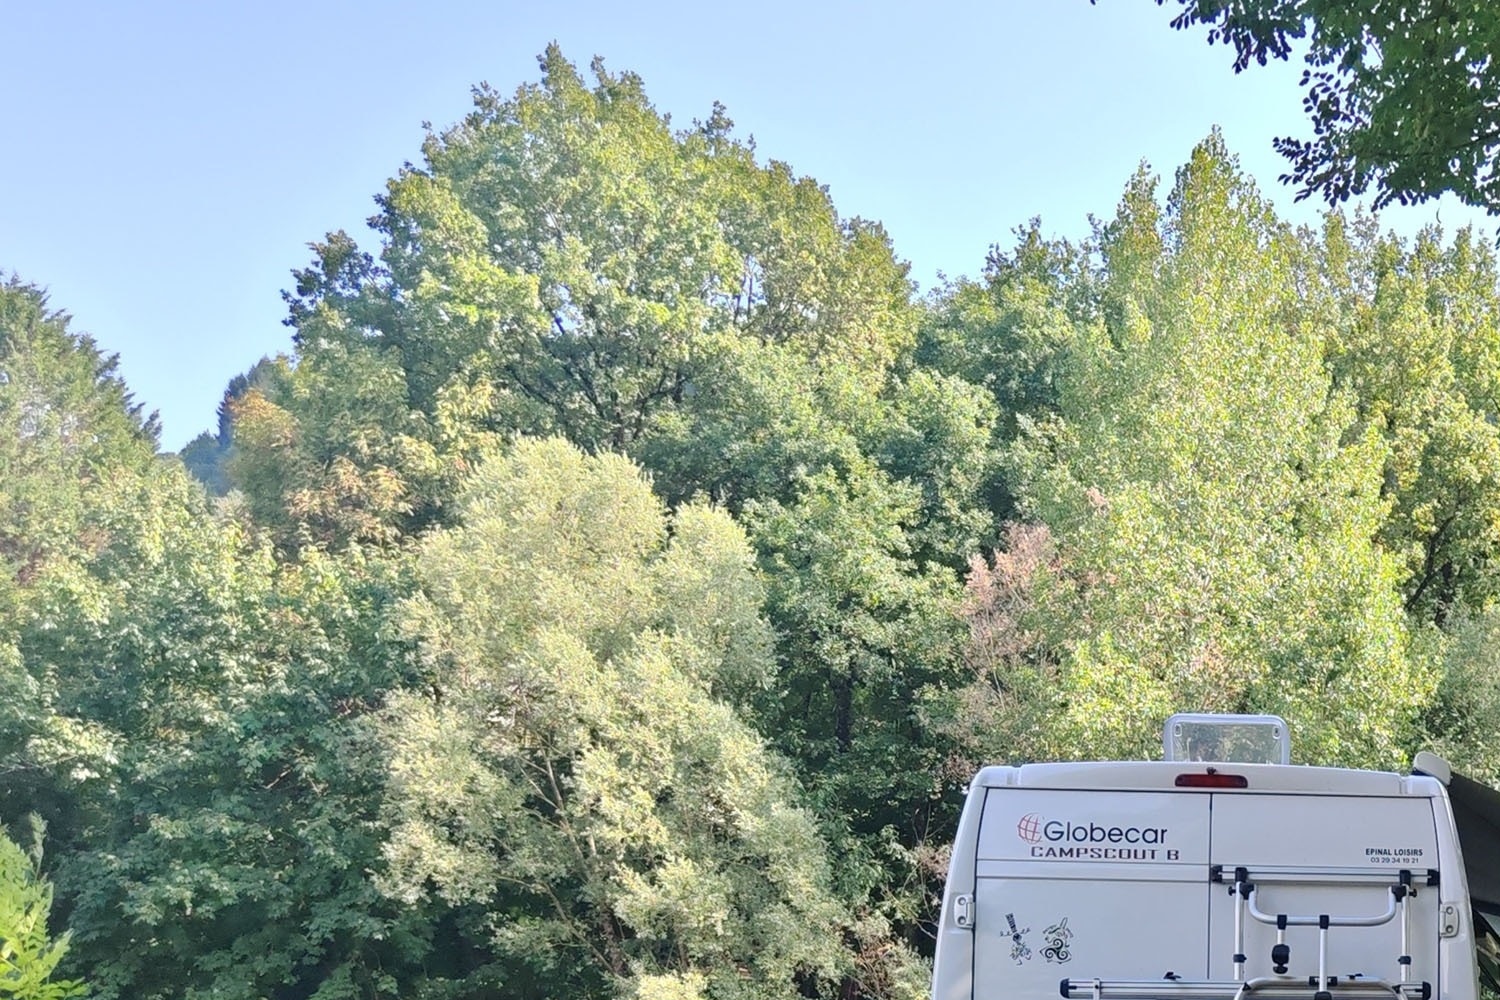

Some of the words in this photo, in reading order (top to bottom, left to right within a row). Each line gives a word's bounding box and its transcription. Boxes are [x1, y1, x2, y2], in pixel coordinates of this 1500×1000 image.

[1044, 820, 1168, 844] Globecar
[1031, 846, 1160, 860] CAMPSCOUT
[1167, 849, 1179, 861] B
[1365, 848, 1392, 856] EPINAL
[1394, 848, 1423, 857] LOISIRS
